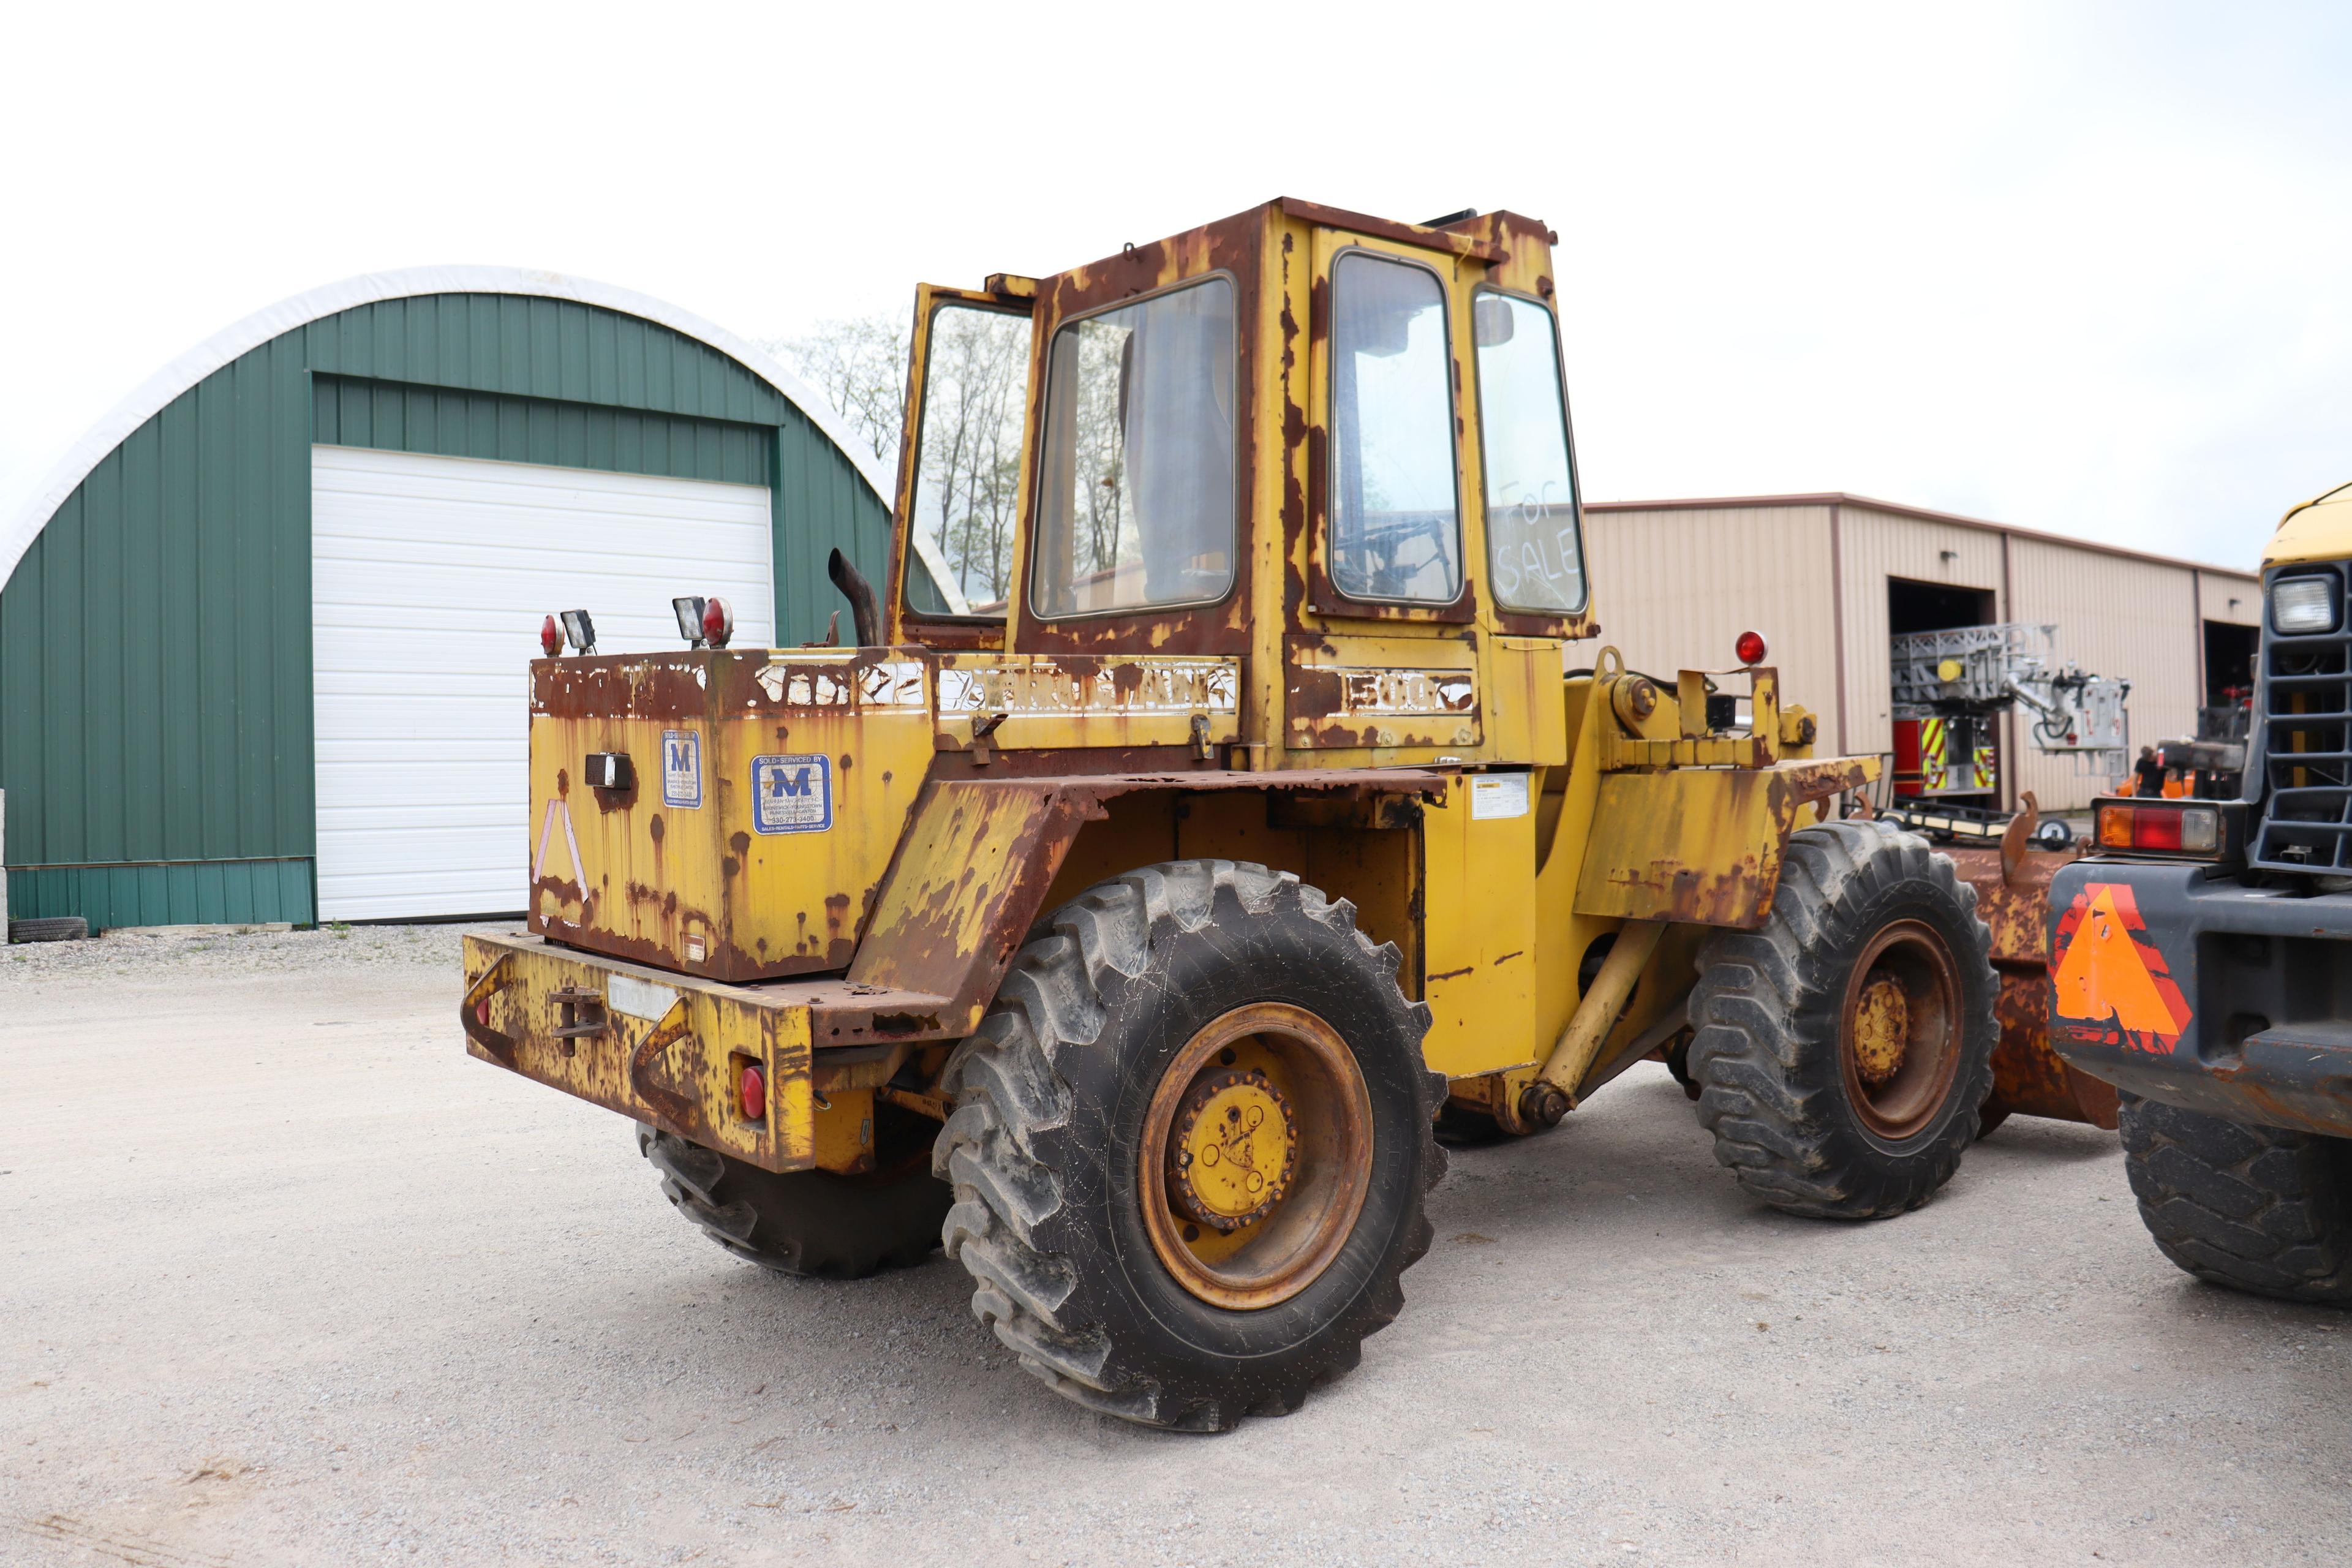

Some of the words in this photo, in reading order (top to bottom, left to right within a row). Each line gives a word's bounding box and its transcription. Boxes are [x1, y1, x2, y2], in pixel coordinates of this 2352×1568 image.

[1496, 528, 1579, 598] SALE
[671, 744, 691, 772] M
[771, 767, 812, 797] M
